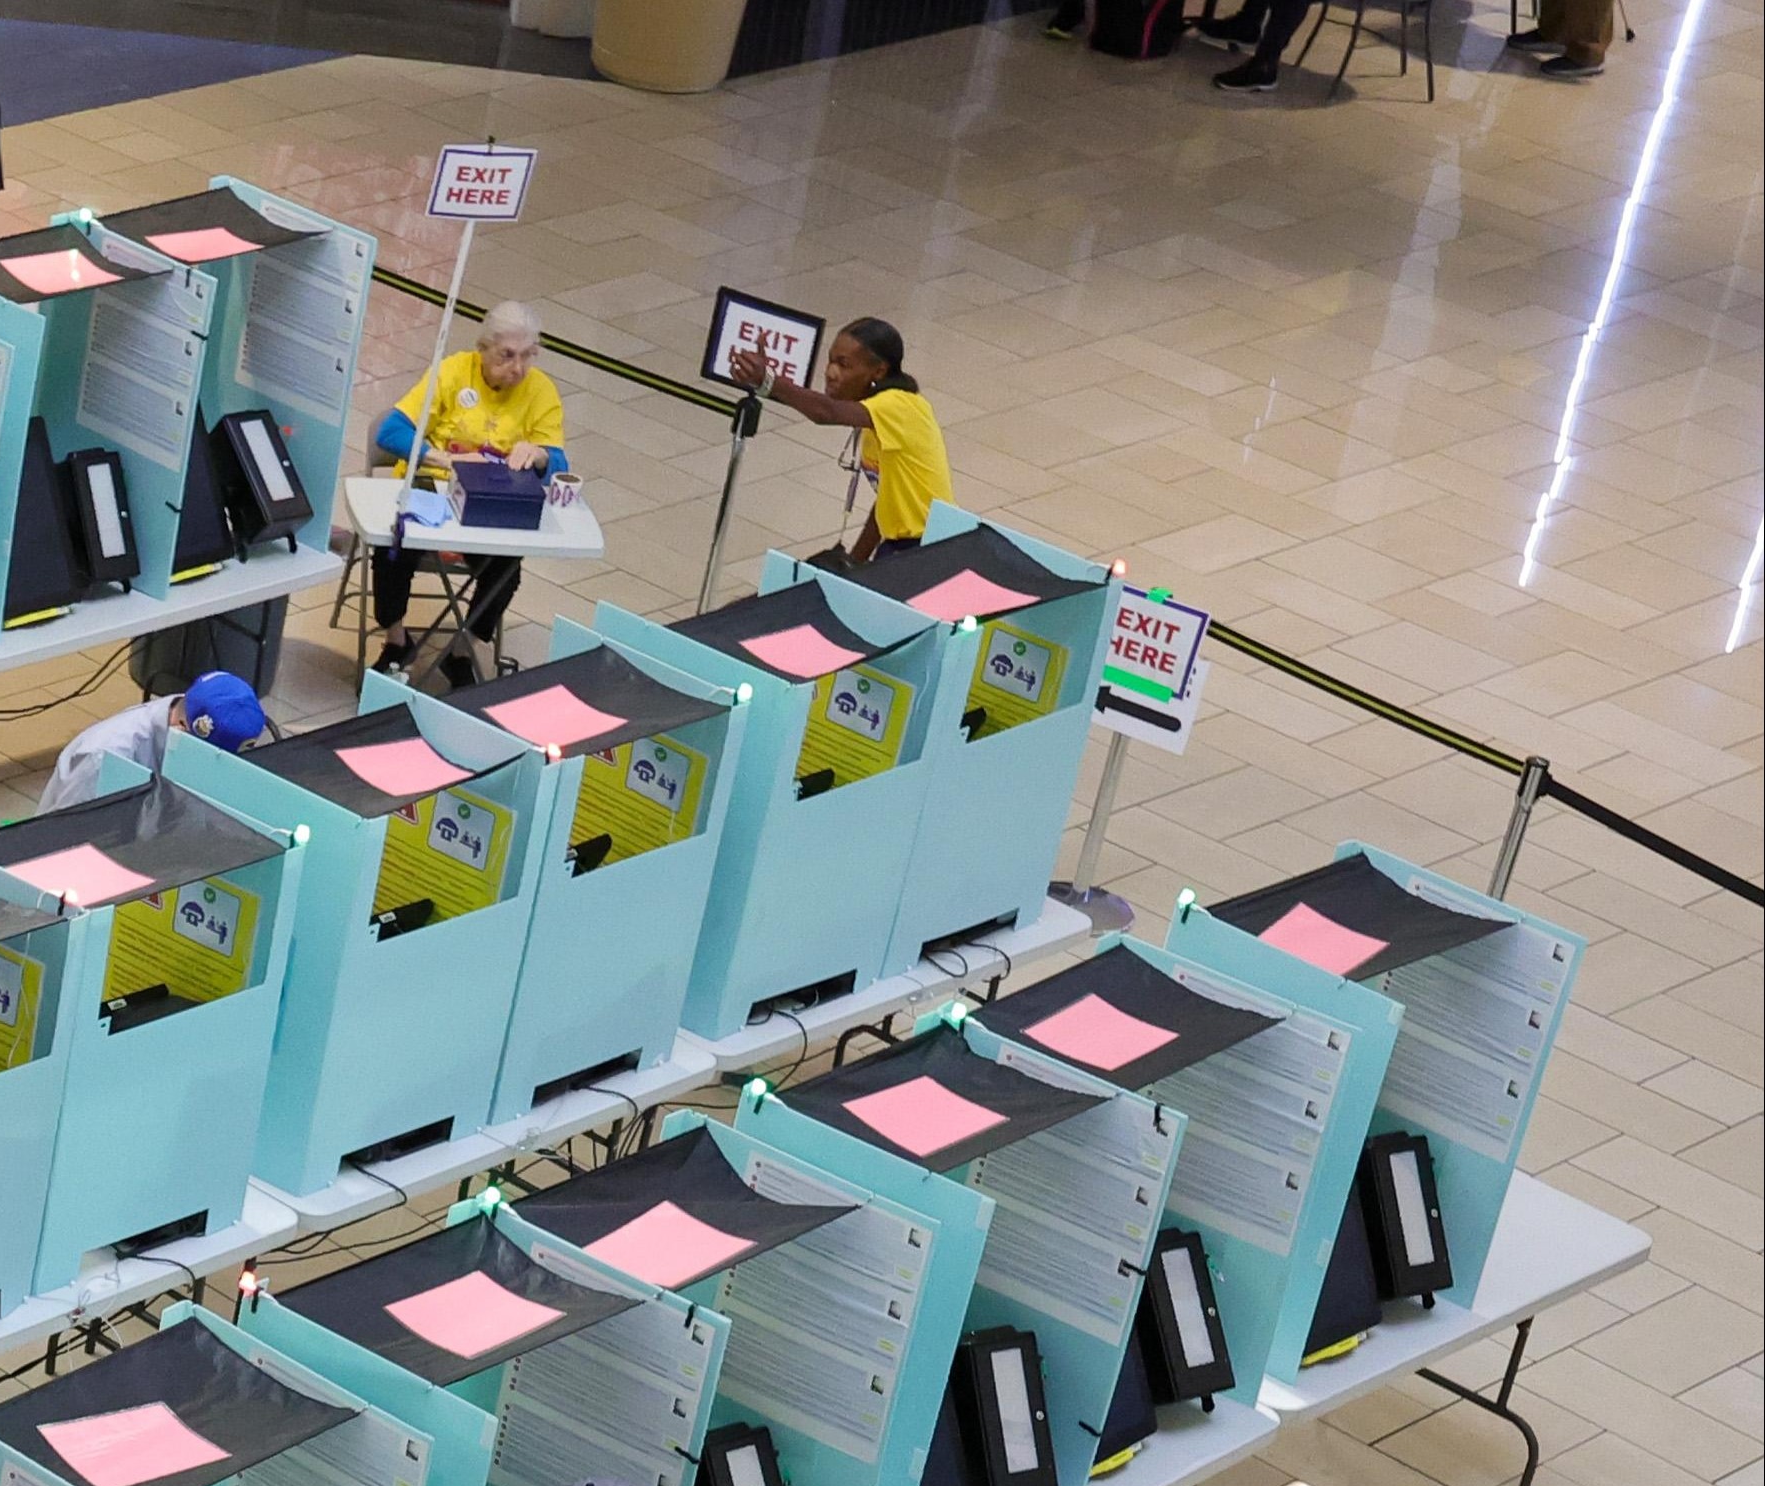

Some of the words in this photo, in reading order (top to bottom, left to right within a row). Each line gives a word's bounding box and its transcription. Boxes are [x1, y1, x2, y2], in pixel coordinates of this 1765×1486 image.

[456, 166, 512, 184] EXIT
[445, 187, 511, 205] HERE
[738, 320, 799, 355] EXIT
[1115, 607, 1181, 645] EXIT
